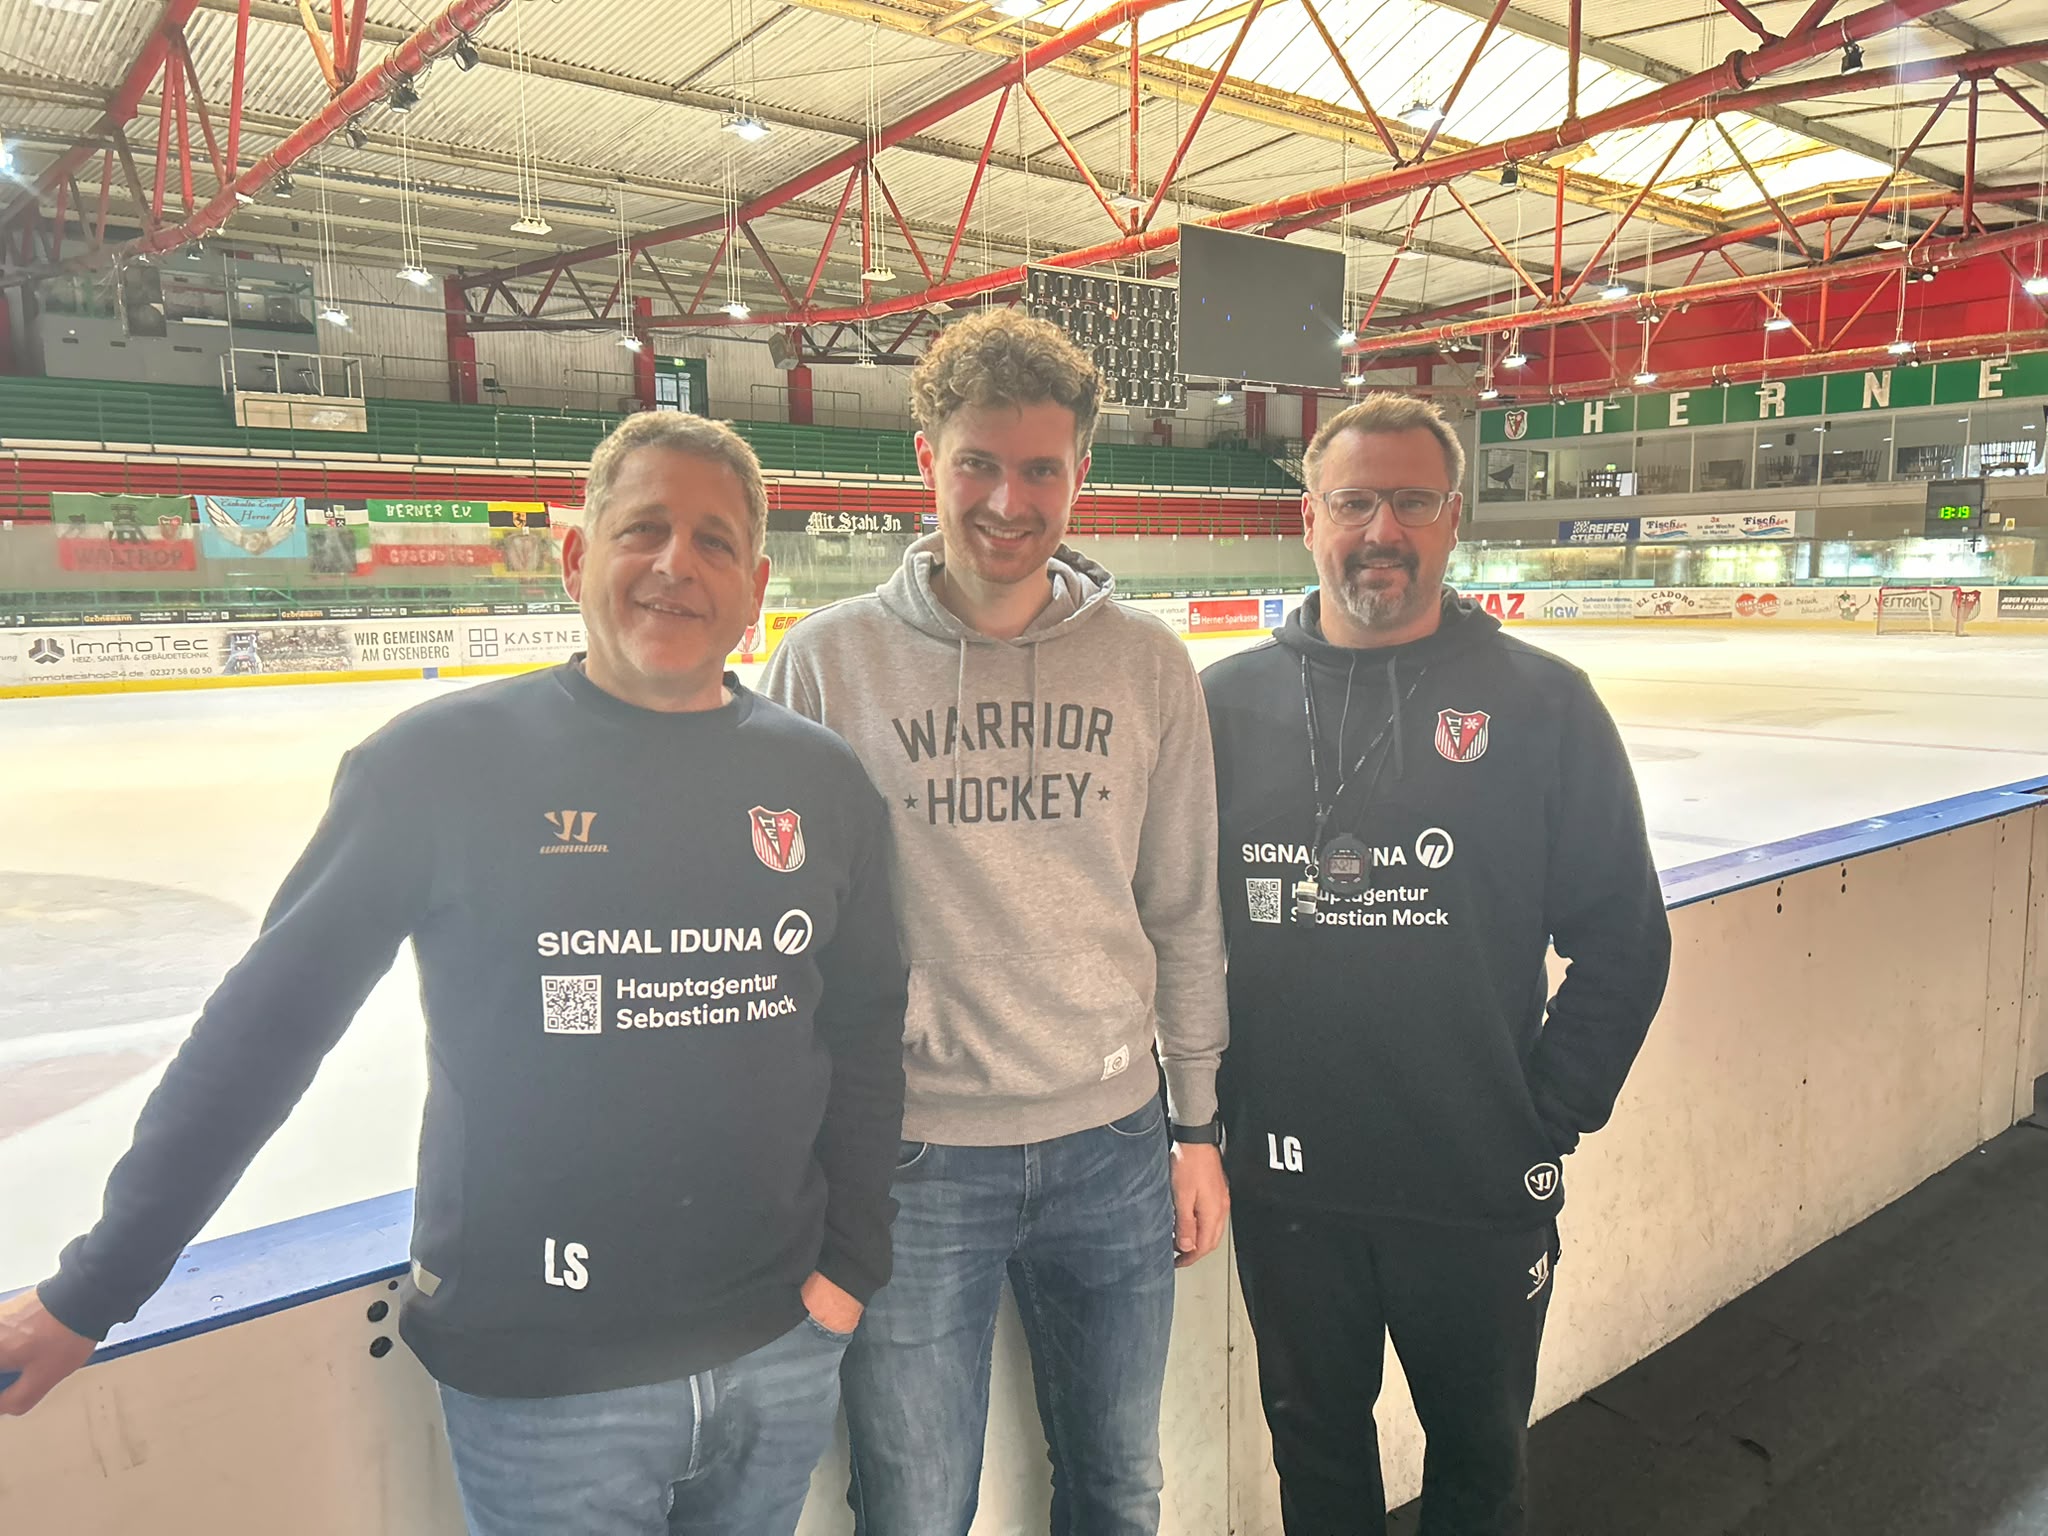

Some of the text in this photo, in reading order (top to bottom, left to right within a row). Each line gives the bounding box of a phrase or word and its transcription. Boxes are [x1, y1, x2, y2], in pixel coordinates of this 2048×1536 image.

[1582, 359, 2004, 435] HERNE
[1743, 515, 1776, 525] Fisch
[1941, 506, 1970, 519] 13:19
[806, 512, 835, 532] Mit
[838, 512, 879, 531] Stahl
[881, 514, 902, 533] In
[1589, 522, 1629, 533] REIFEN
[1646, 519, 1676, 529] Fisch
[75, 548, 182, 565] WALTROP
[1459, 593, 1525, 620] AZ
[1636, 597, 1649, 608] EL
[1651, 591, 1695, 608] CADORO
[1201, 613, 1258, 626] Herner Sparkasse
[1543, 607, 1578, 618] HGW
[71, 636, 209, 655] ImmoTec
[354, 630, 454, 646] WIR GEMEINSAM
[142, 652, 209, 660] GEBÄUDETECHNIK
[361, 646, 450, 661] AM GYSENBERG
[150, 668, 176, 677] 02327
[178, 667, 188, 675] 58
[190, 667, 200, 675] 60
[892, 701, 1113, 763] WARRIOR
[927, 772, 1092, 825] HOCKEY
[1392, 908, 1449, 926] Mock
[537, 927, 763, 957] SIGNAL IDUNA
[616, 973, 778, 1001] Hauptagentur
[616, 995, 797, 1030] Sebastian Mock
[1267, 1132, 1304, 1173] LG
[544, 1237, 589, 1290] LS
